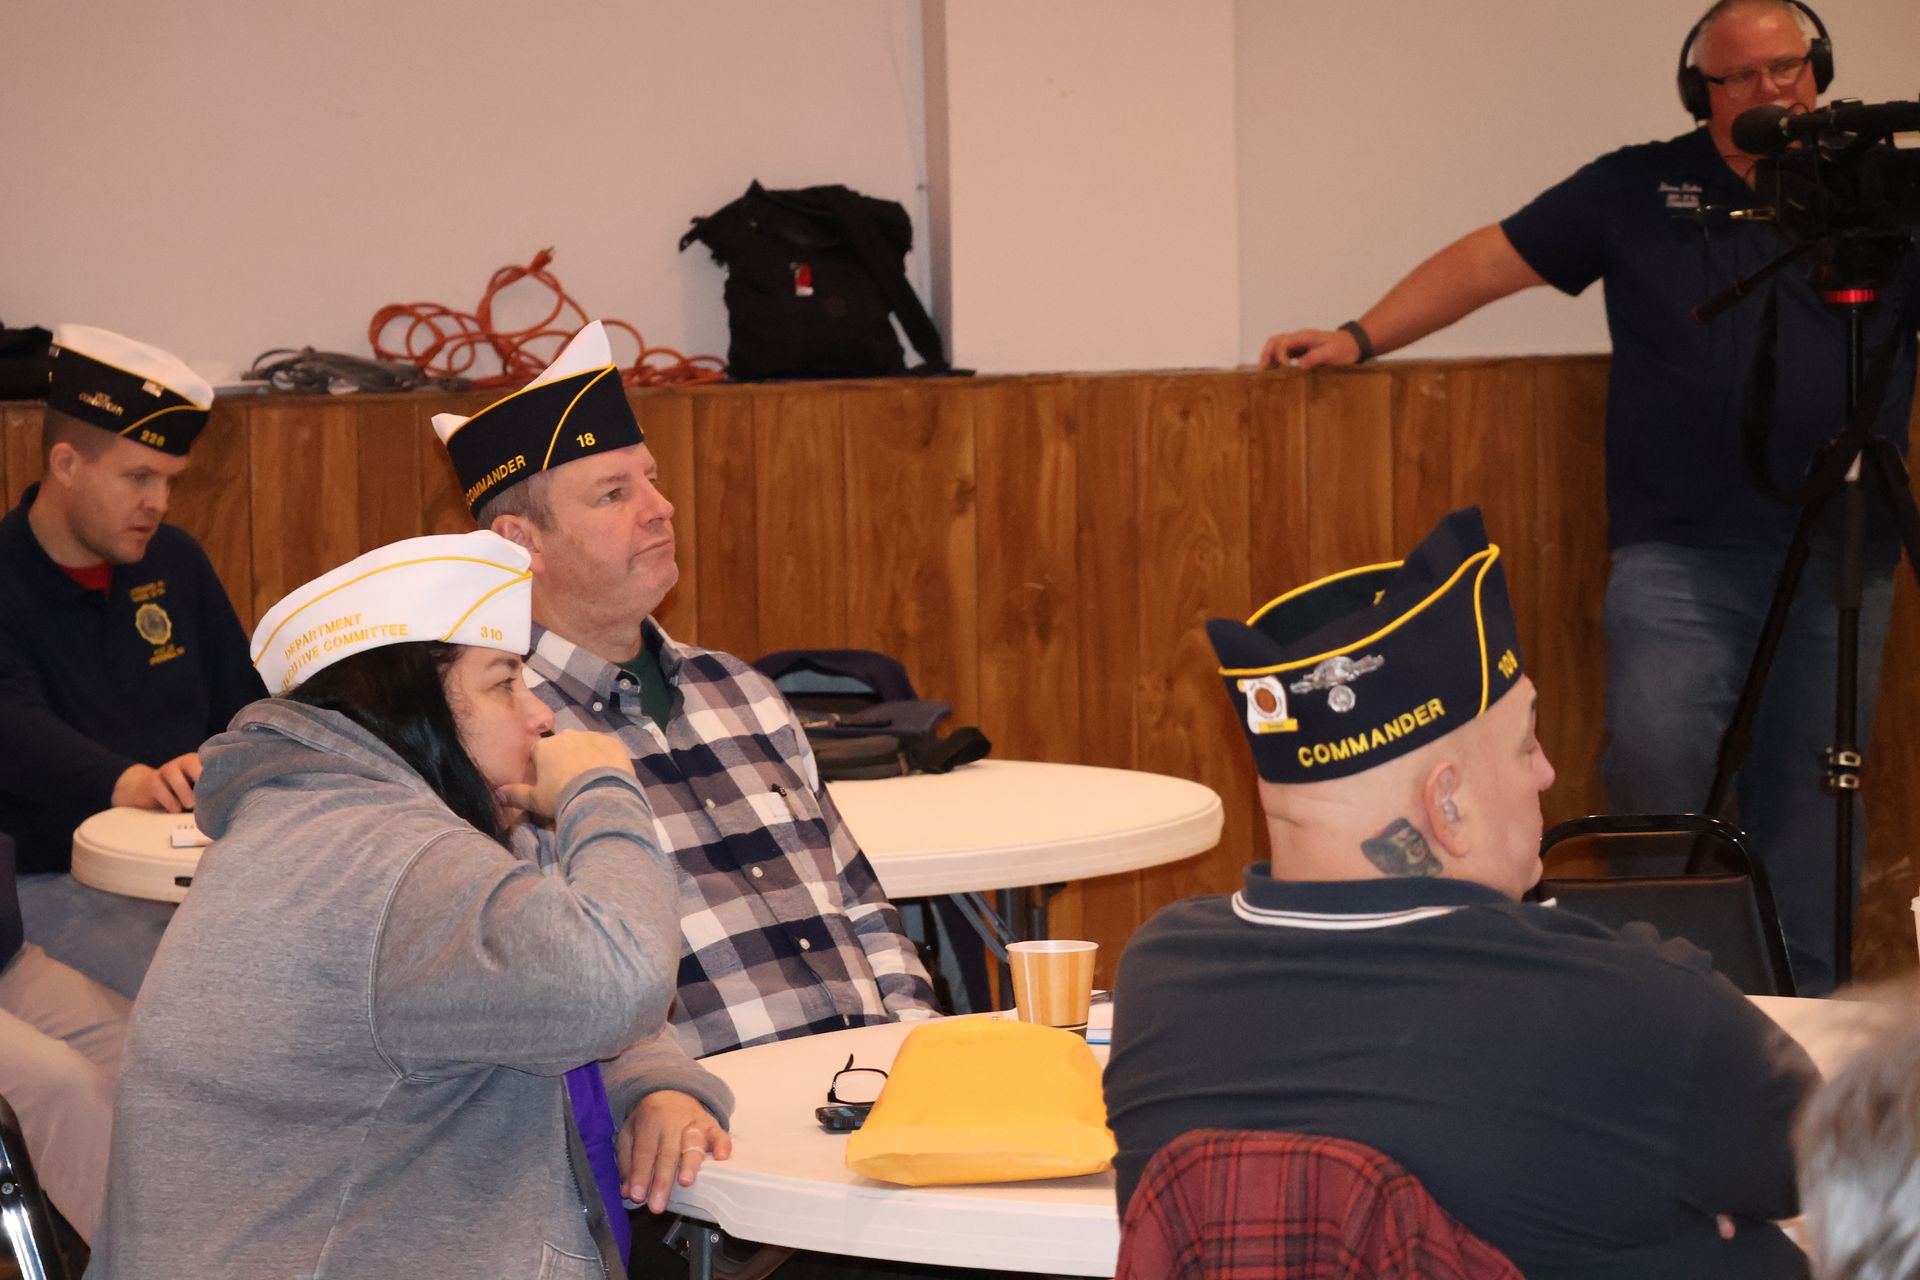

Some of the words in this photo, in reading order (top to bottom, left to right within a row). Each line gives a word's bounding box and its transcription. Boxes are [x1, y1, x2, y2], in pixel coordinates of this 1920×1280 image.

[576, 432, 596, 448] 18
[284, 612, 363, 661] DEPARTMENT
[323, 623, 408, 652] COMMITTEE
[480, 625, 503, 642] 310
[1298, 697, 1446, 768] COMMANDER
